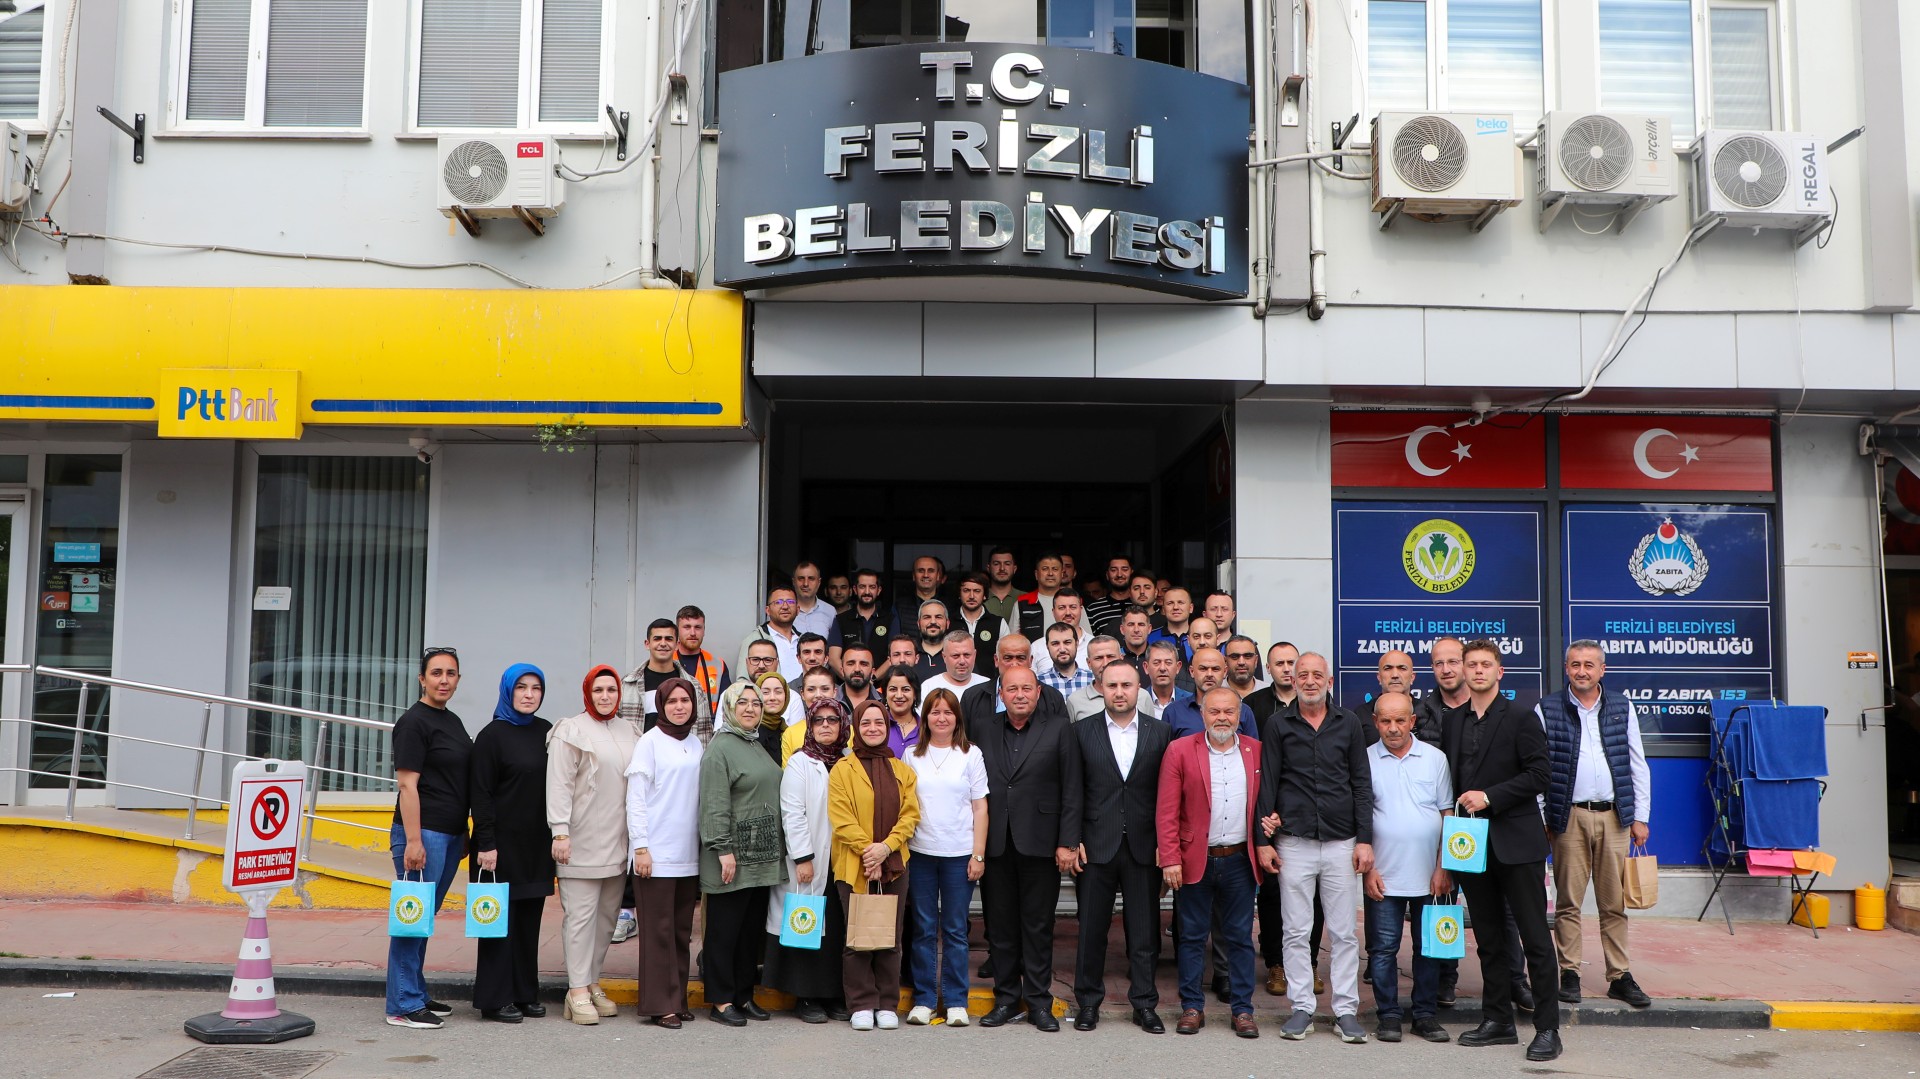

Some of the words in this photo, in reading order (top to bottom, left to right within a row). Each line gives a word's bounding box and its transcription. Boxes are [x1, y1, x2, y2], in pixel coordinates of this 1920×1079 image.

[920, 51, 1070, 106] T.C.
[1476, 117, 1508, 129] beko
[824, 109, 1154, 187] FERİZLİ
[1645, 118, 1660, 160] arçelik
[520, 146, 540, 154] TCL
[1801, 142, 1819, 202] REGAL
[743, 191, 1226, 275] BELEDİYESİ
[1405, 549, 1429, 588] FERİZLİ
[1431, 548, 1475, 592] BELEDİYESİ
[1375, 618, 1424, 634] FERİZLİ
[1428, 618, 1506, 634] BELEDİYESİ
[1605, 618, 1653, 634] FERİZLİ
[1658, 619, 1736, 635] BELEDİYESİ
[1357, 640, 1415, 654] ZABITA
[1592, 640, 1646, 654] ABITA
[1650, 636, 1753, 655] MÜDÜRLÜĞÜ
[1657, 689, 1714, 700] ZABITA
[1719, 689, 1747, 700] 153
[238, 855, 257, 869] PARK
[258, 850, 292, 867] ETMEYİNİZ
[238, 870, 254, 880] RESMİ
[253, 868, 277, 880] ARAÇLARA
